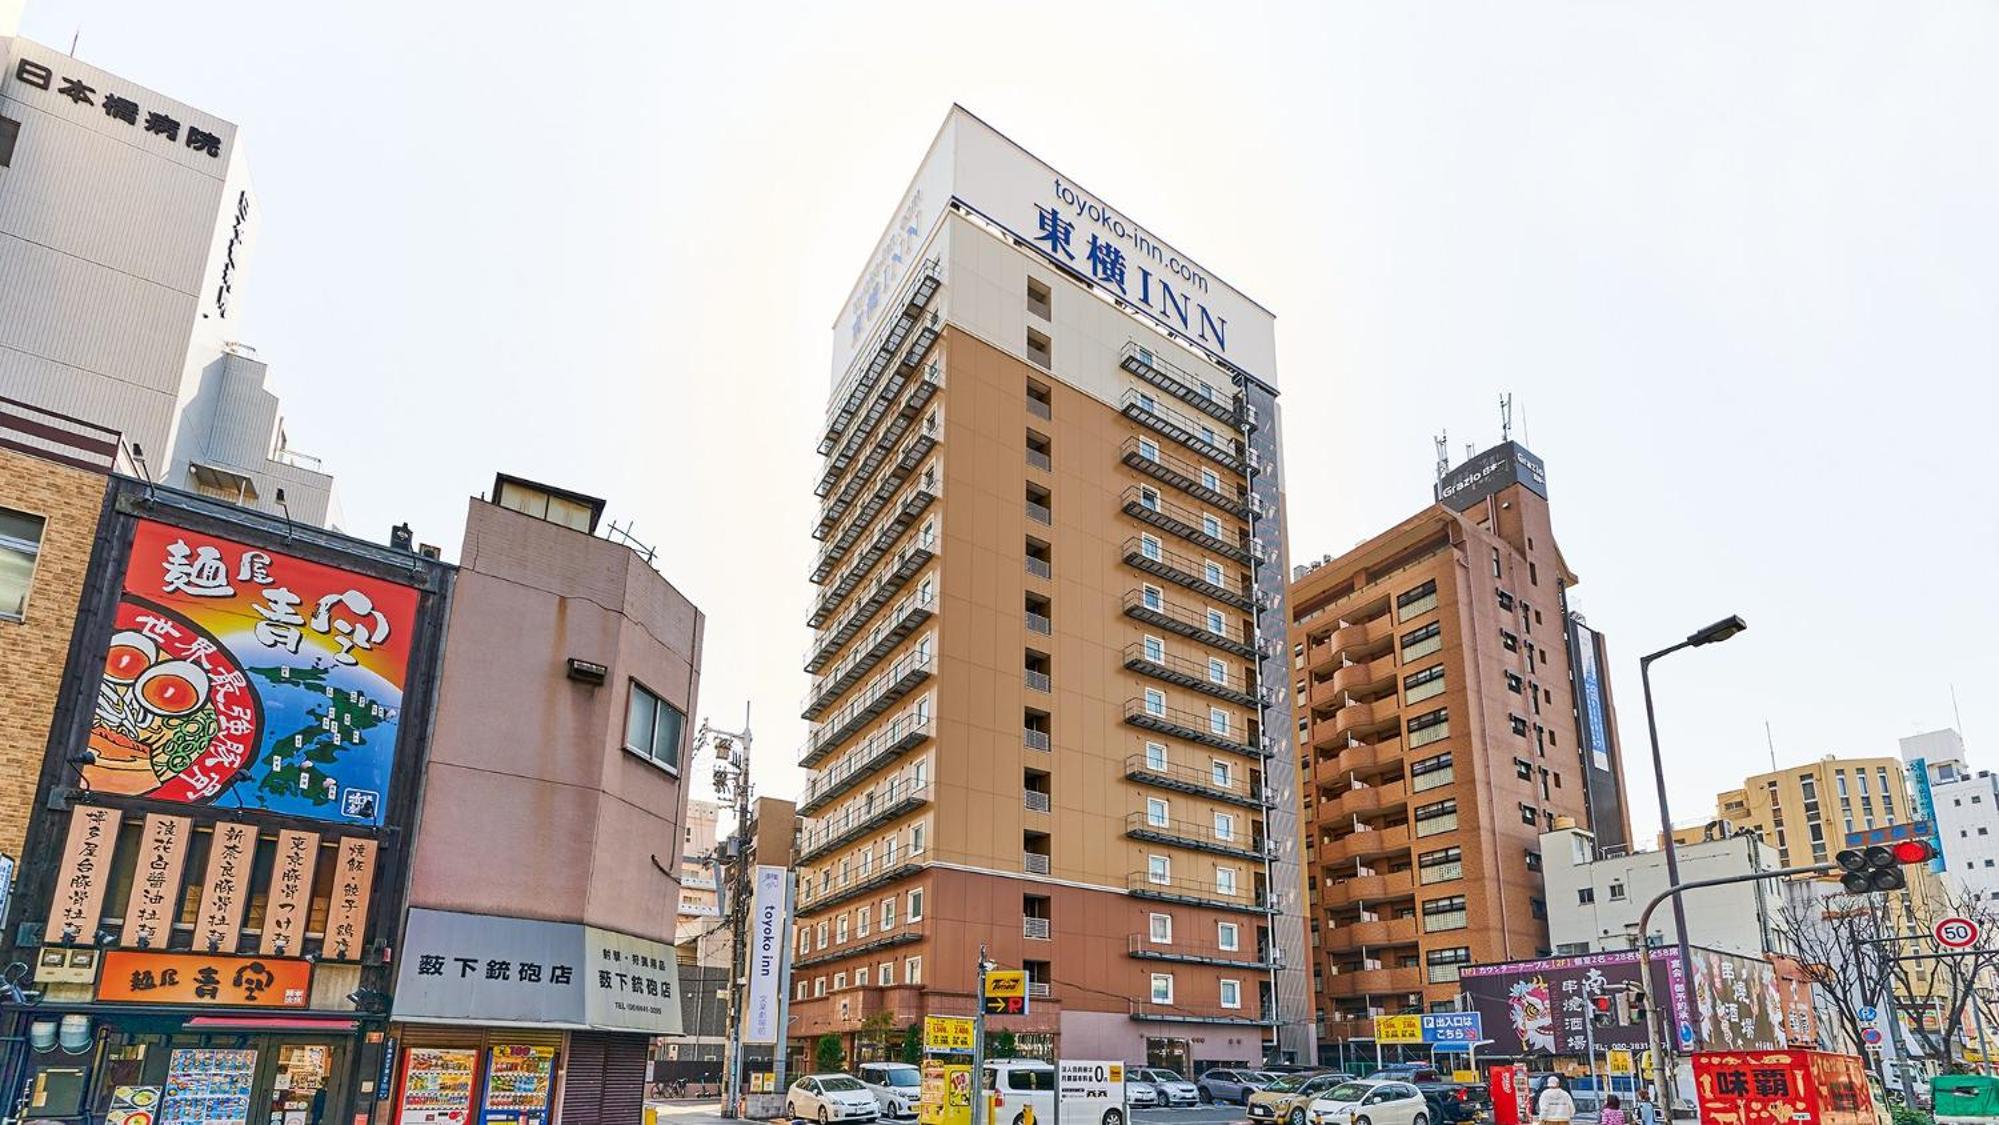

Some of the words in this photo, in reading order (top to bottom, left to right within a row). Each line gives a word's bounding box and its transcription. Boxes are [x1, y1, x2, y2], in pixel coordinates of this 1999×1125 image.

[16, 58, 222, 158] 日本橋病院
[1053, 177, 1211, 295] toyoko-inn.com
[1033, 202, 1228, 353] 東横INN
[1442, 471, 1482, 498] Grazio
[761, 905, 776, 952] toyoko
[1944, 926, 1968, 940] 50
[760, 955, 773, 977] inn
[614, 1002, 626, 1011] TEL
[1436, 1016, 1473, 1027] 出入口は
[1437, 1028, 1464, 1039] こちら
